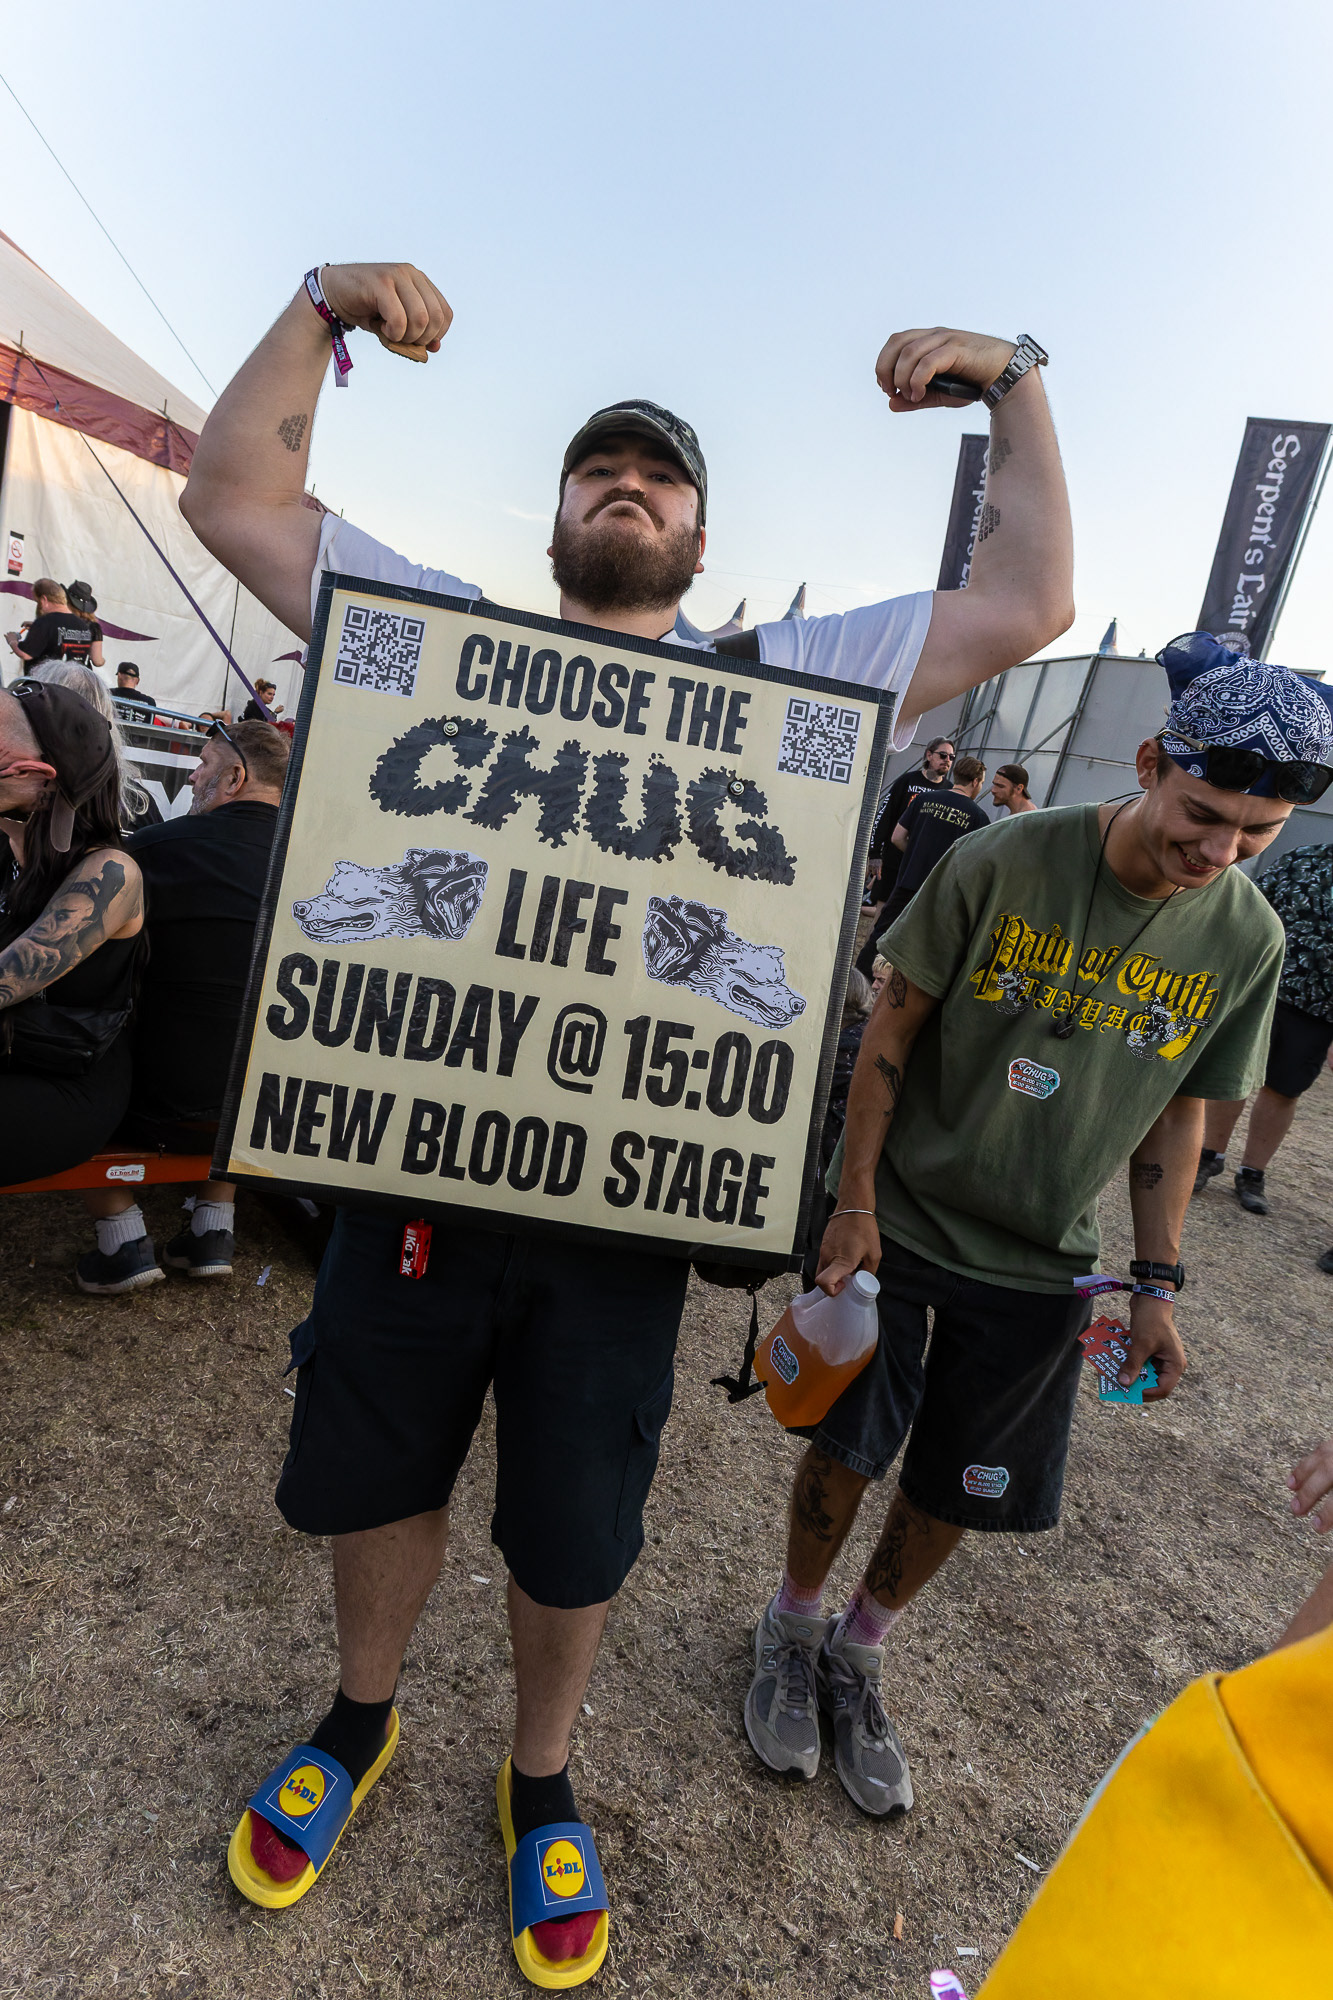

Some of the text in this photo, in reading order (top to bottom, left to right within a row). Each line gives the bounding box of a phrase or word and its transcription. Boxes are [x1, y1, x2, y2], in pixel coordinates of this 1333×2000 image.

[1244, 434, 1301, 566] Serpent's
[1228, 572, 1266, 630] Lair
[455, 634, 752, 755] CHOOSE THE
[369, 715, 798, 886] CHUG
[922, 801, 971, 820] BLASPHEMY
[933, 808, 970, 829] FLESH
[494, 869, 629, 977] LIFE
[266, 952, 795, 1125] SUNDAY @ 15:00
[970, 914, 1220, 1061] Pain of Truth
[1023, 1066, 1047, 1081] CHUG
[249, 1072, 775, 1229] NEW BLOOD STAGE
[401, 1235, 416, 1275] Koak
[977, 1471, 998, 1481] CHUG
